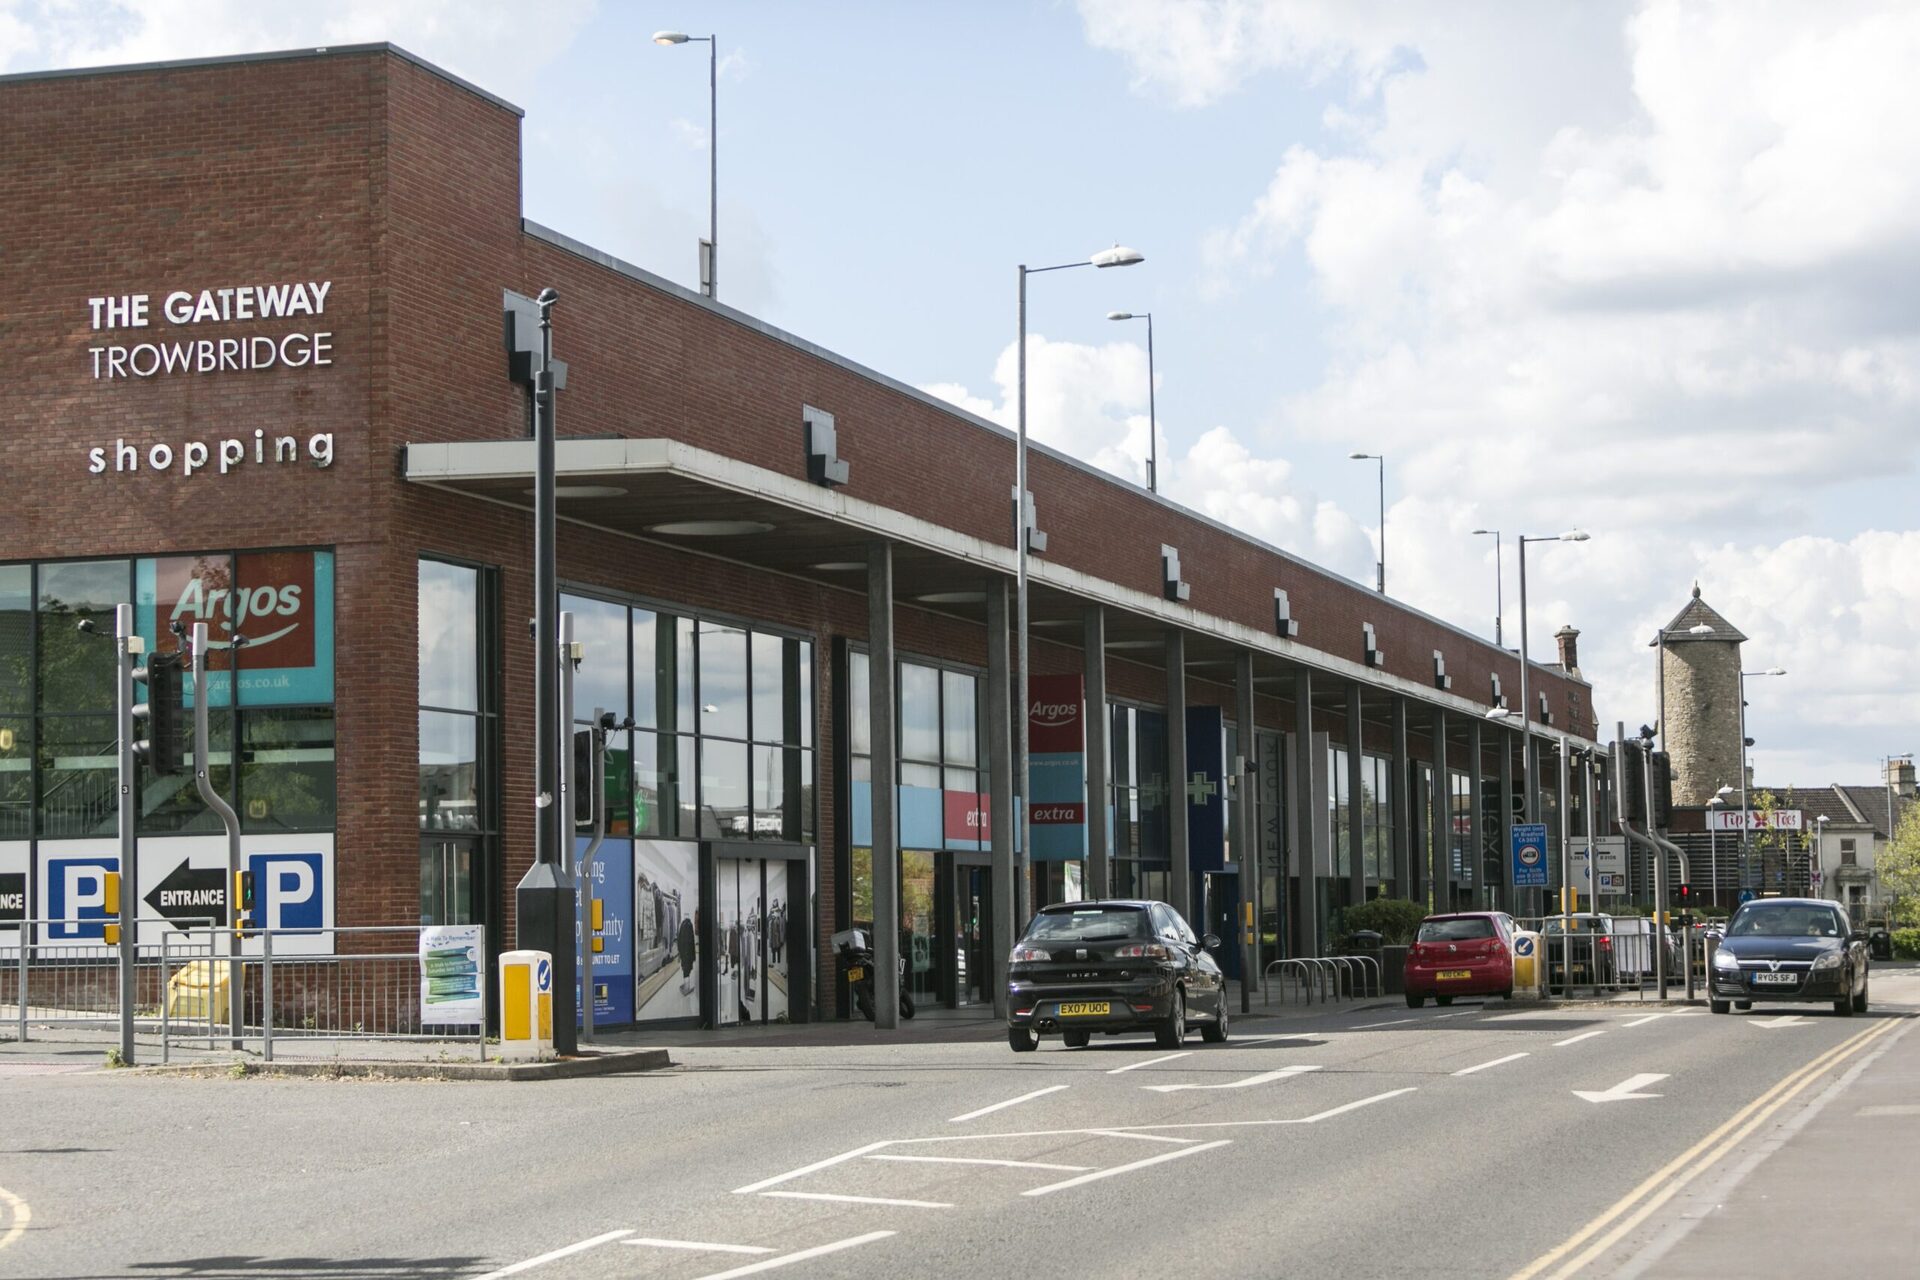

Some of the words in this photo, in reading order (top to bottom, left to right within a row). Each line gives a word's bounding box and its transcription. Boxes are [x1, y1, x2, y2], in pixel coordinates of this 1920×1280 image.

[88, 294, 149, 329] THE
[164, 281, 331, 324] GATEWAY
[88, 332, 332, 379] TROWBRIDGE
[89, 428, 333, 476] shopping
[169, 578, 302, 632] Argos
[1029, 701, 1078, 719] Argos
[122, 786, 129, 794] 3
[1034, 807, 1075, 820] extra
[64, 865, 107, 934] P
[160, 889, 225, 907] ENTRANCE
[266, 861, 315, 929] P
[1061, 1003, 1087, 1014] EX07
[1088, 1003, 1108, 1013] UOC
